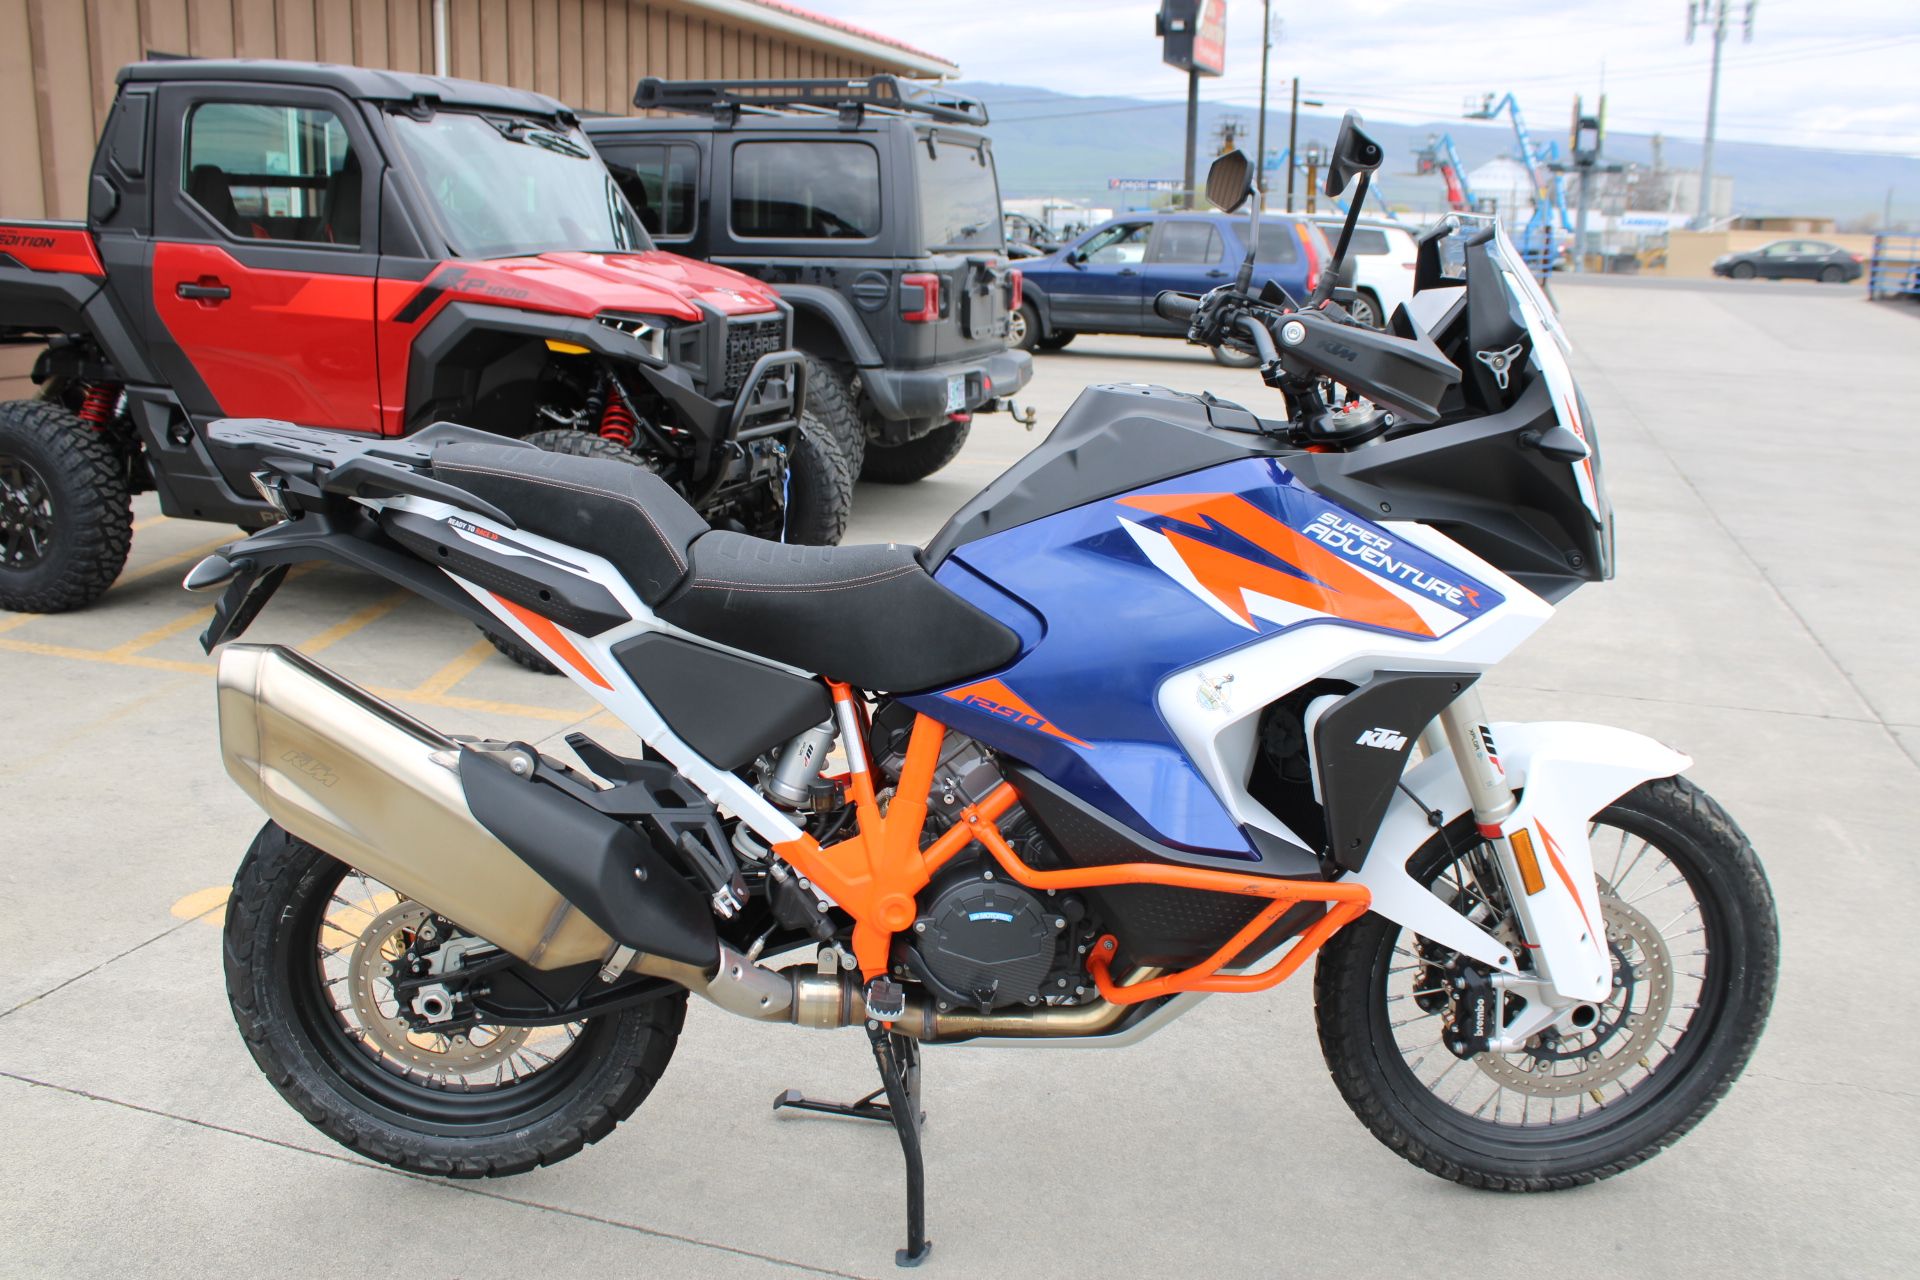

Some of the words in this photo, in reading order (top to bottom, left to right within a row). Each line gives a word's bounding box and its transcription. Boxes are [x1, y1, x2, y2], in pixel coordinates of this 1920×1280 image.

[730, 335, 780, 353] POLARIS
[1317, 341, 1359, 362] KTM
[447, 517, 467, 529] READY
[467, 524, 476, 533] TO
[1317, 512, 1393, 551] SUPER
[961, 694, 1047, 729] 1290
[1355, 727, 1408, 752] KTM
[280, 750, 340, 788] KTM
[1473, 998, 1485, 1037] brembo
